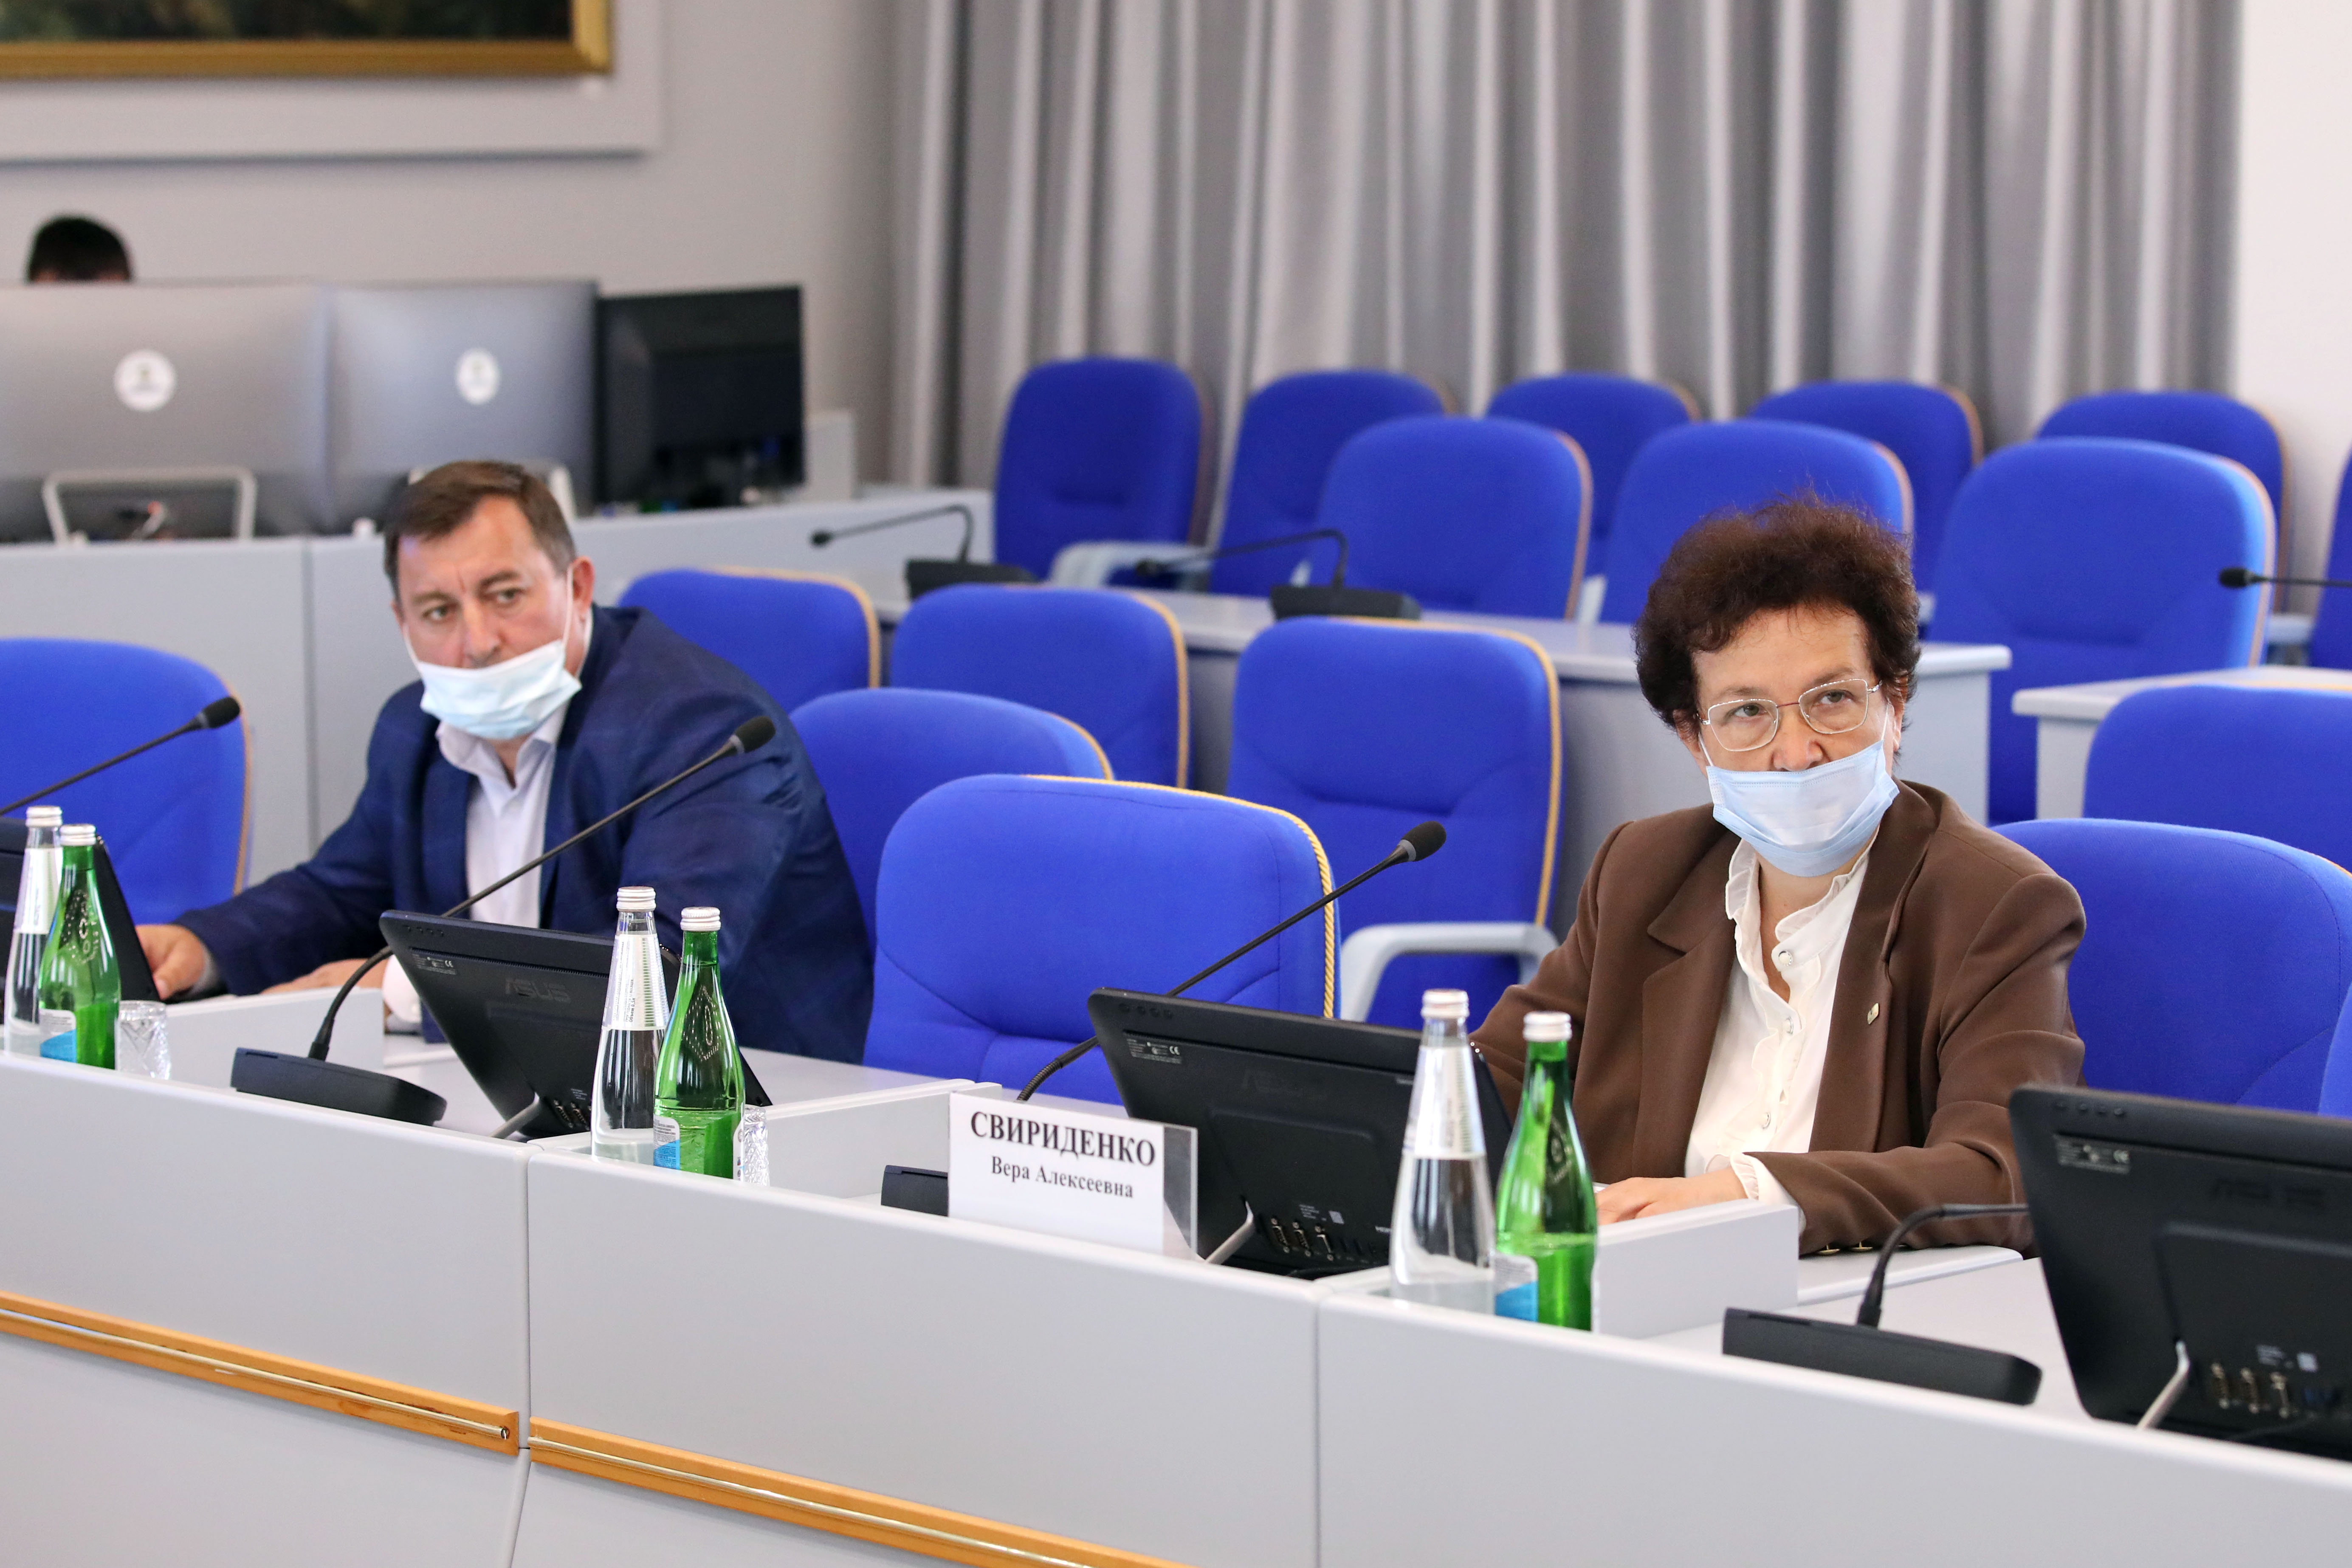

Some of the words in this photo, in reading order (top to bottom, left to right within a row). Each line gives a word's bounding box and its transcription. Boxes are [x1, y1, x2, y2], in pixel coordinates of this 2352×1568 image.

[971, 1111, 1155, 1166] СВИРИДЕНКО
[991, 1156, 1030, 1182] Вера
[1035, 1166, 1134, 1198] Алексеевна
